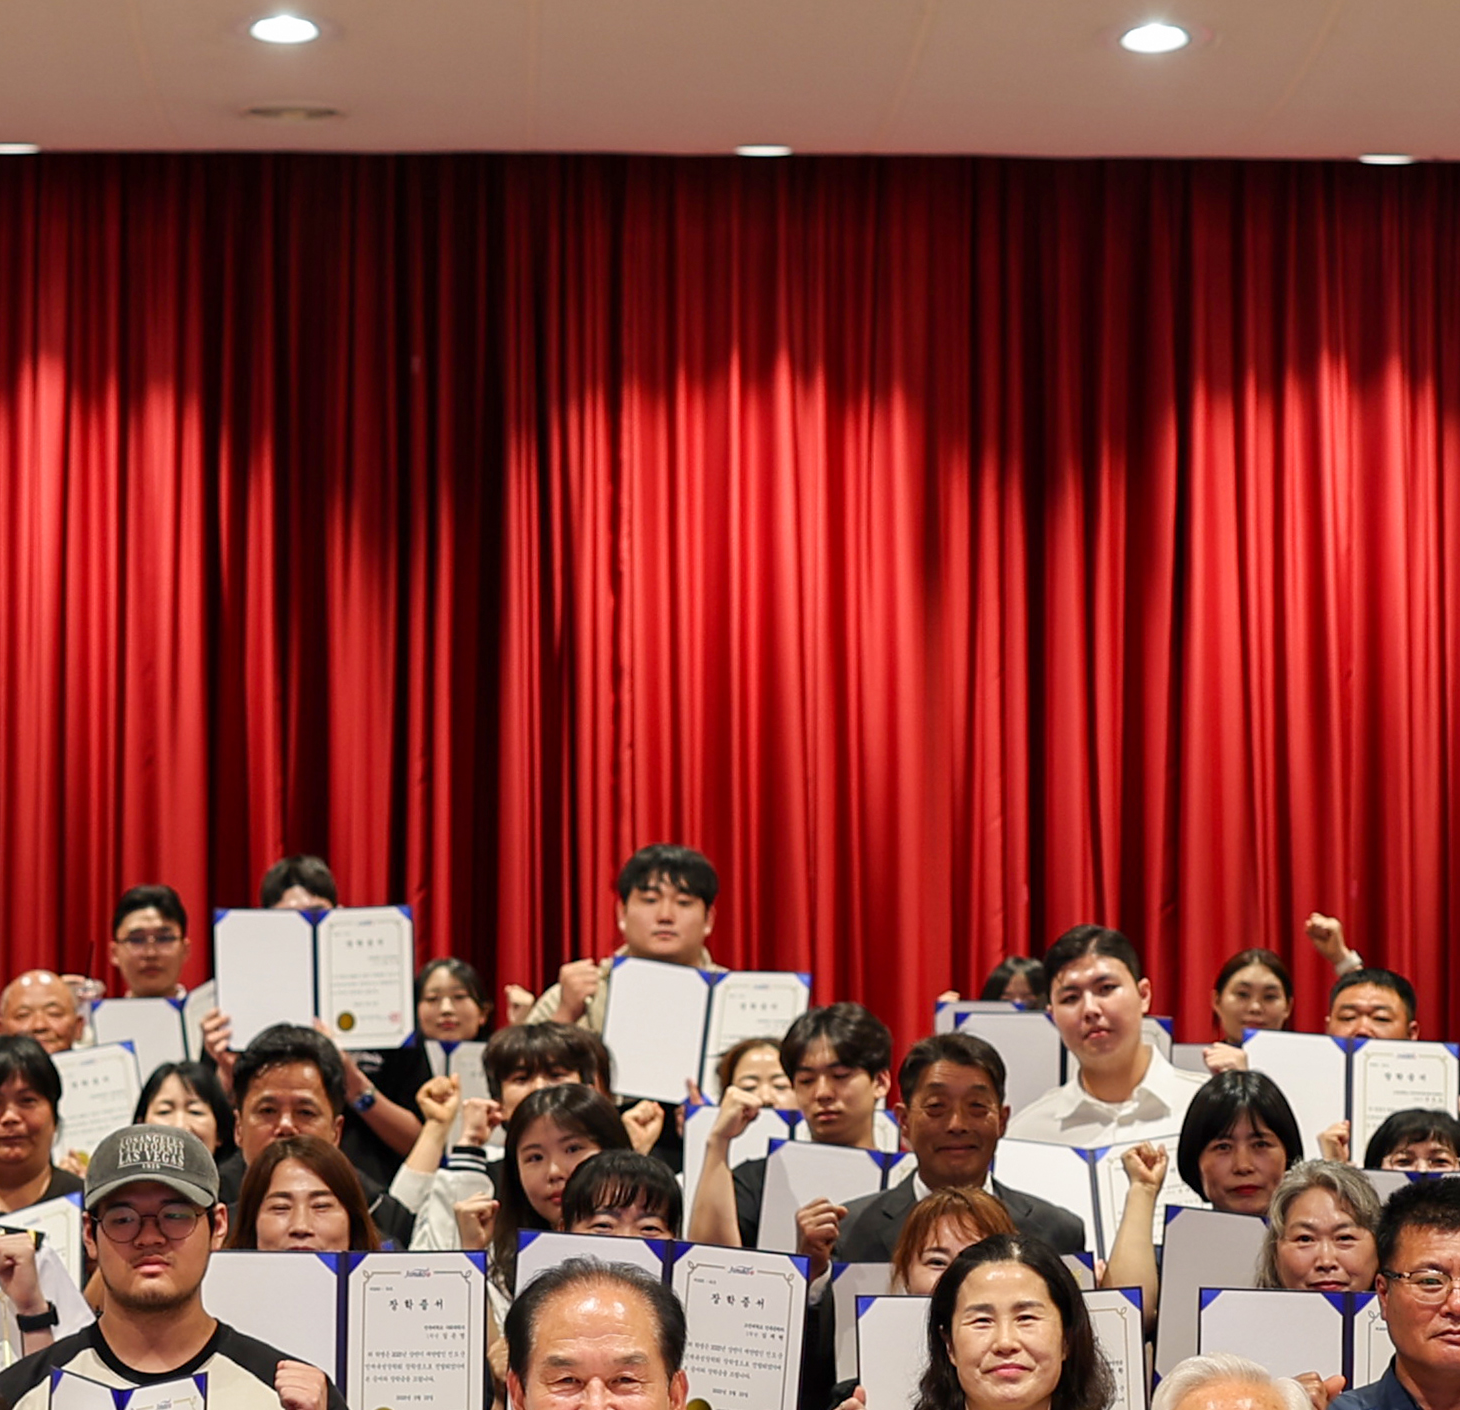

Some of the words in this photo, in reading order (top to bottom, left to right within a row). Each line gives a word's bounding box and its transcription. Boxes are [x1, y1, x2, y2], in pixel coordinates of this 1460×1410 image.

[119, 1151, 141, 1166] LAS
[145, 1150, 185, 1167] VEGAS
[388, 1298, 444, 1311] 장학증서
[711, 1292, 765, 1310] 장학증서
